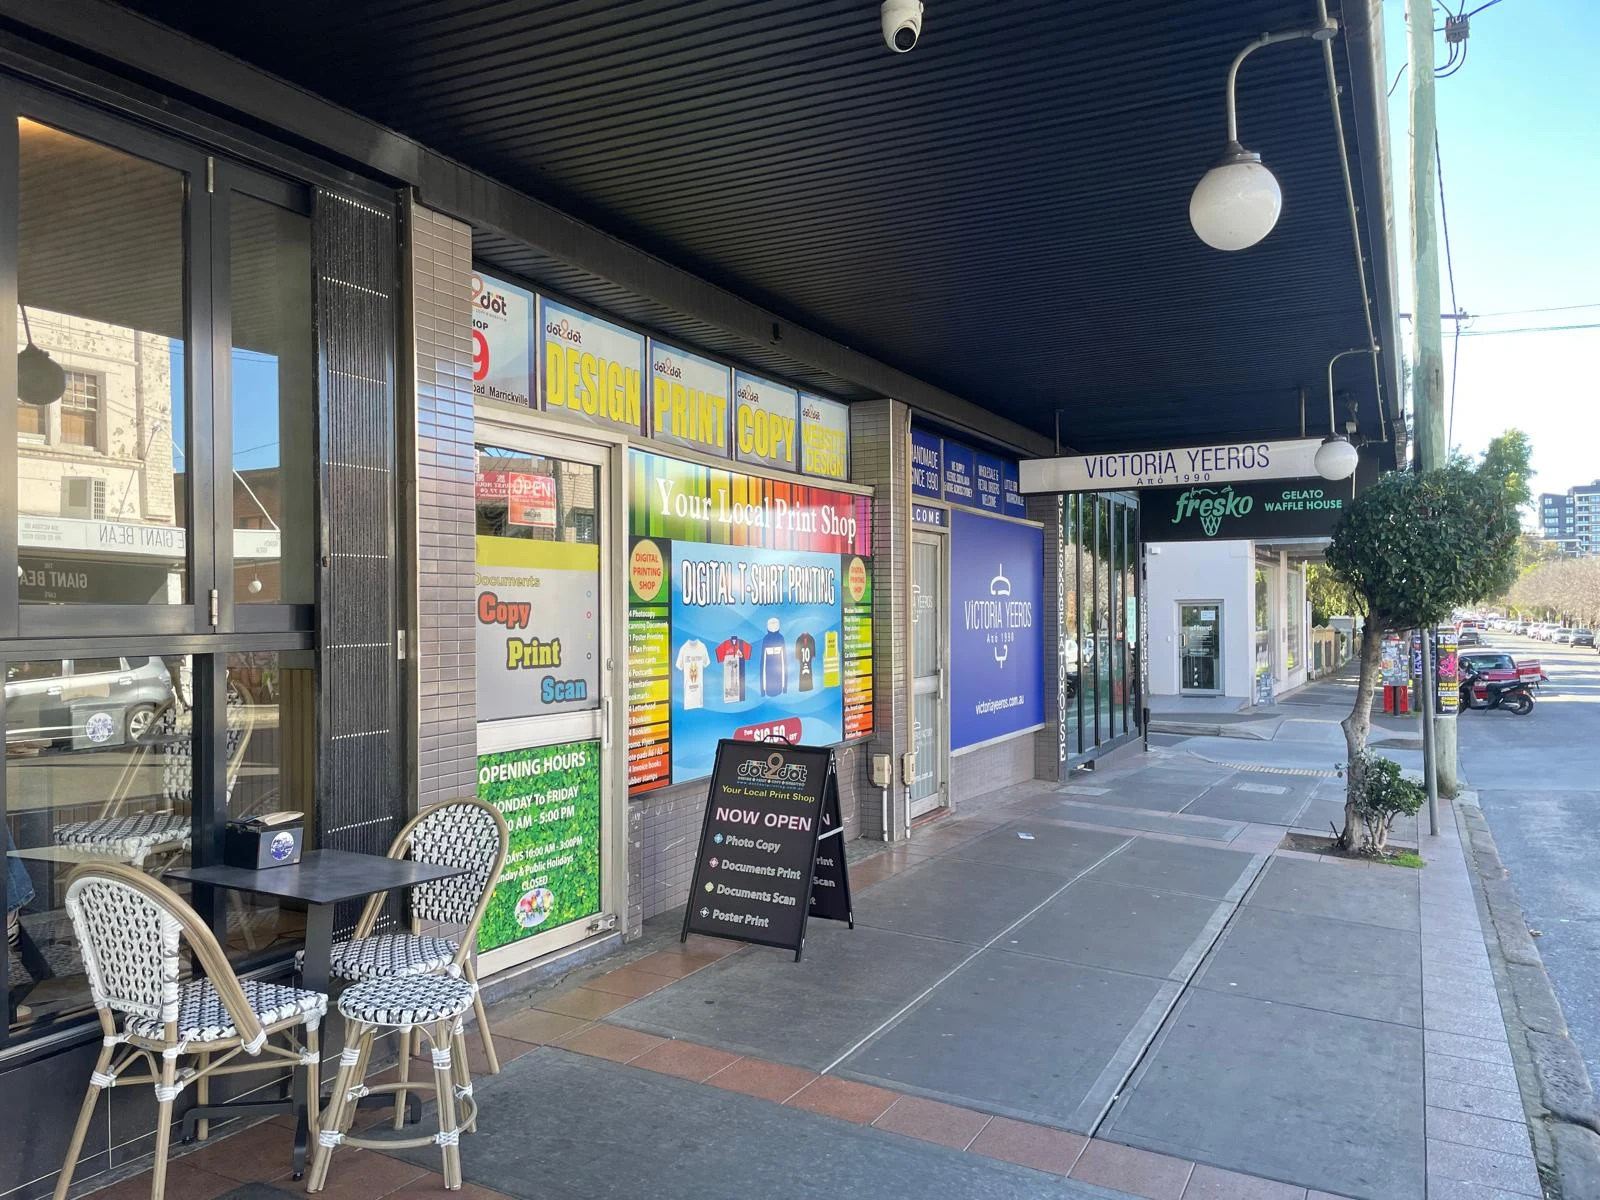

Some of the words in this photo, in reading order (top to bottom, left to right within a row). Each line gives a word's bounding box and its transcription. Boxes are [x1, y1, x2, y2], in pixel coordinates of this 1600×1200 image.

[546, 341, 641, 427] DESIGN
[489, 386, 528, 406] Marrickville
[654, 377, 726, 448] PRINT
[737, 403, 795, 463] COPY
[806, 449, 844, 478] DESIGN
[912, 444, 938, 470] ANDMADE
[1187, 444, 1270, 473] YEEROS
[512, 477, 552, 498] OPEN
[926, 472, 938, 491] 1990
[1175, 473, 1211, 483] 1990
[1282, 489, 1324, 500] GELATO
[656, 478, 712, 521] Your
[718, 488, 770, 528] Local
[775, 497, 817, 533] Print
[821, 505, 856, 544] Shop
[1172, 489, 1254, 524] fresko
[1264, 502, 1304, 512] WAFFLE
[1306, 499, 1343, 510] HOUSE
[912, 508, 940, 524] COME
[636, 552, 659, 563] DIGITAL
[633, 567, 661, 577] PRINTING
[639, 580, 656, 590] SHOP
[682, 559, 736, 607] DIGITAL
[738, 560, 785, 606] T-SHIRT
[788, 565, 835, 606] PRINTING
[478, 591, 531, 629] Copy
[632, 610, 656, 619] Photocopy
[1004, 601, 1032, 628] YEEROS
[629, 622, 646, 631] canning
[1001, 632, 1015, 642] 1990
[506, 637, 561, 670] Print
[801, 648, 810, 662] 10
[541, 675, 587, 704] Scan
[975, 694, 1025, 715] victoriayeeros.com.au
[479, 758, 541, 785] OPENING
[544, 751, 586, 773] HOURS
[737, 752, 808, 782] dot2dot
[629, 777, 642, 786] ubber
[534, 793, 546, 806] To
[546, 785, 579, 804] FRIDAY
[722, 785, 742, 795] Your
[744, 786, 767, 797] Local
[768, 790, 790, 800] Print
[792, 792, 815, 804] Shop
[516, 815, 532, 830] AM
[539, 808, 560, 825] 5:00
[560, 805, 575, 819] PM
[716, 807, 760, 825] NOW
[764, 812, 812, 832] OPEN
[525, 847, 544, 859] 10:00
[544, 843, 556, 854] AM
[726, 834, 754, 849] Photo
[756, 839, 781, 854] Copy
[518, 866, 524, 876] &
[525, 861, 546, 875] Public
[546, 854, 574, 869] Holidays
[722, 860, 776, 877] Documents
[777, 866, 801, 880] Print
[816, 856, 834, 866] rint
[522, 875, 548, 891] CLOSED
[813, 876, 836, 888] Scan
[716, 884, 771, 902] Documents
[772, 892, 796, 906] Scan
[712, 908, 744, 924] Poster
[744, 914, 770, 928] Print
